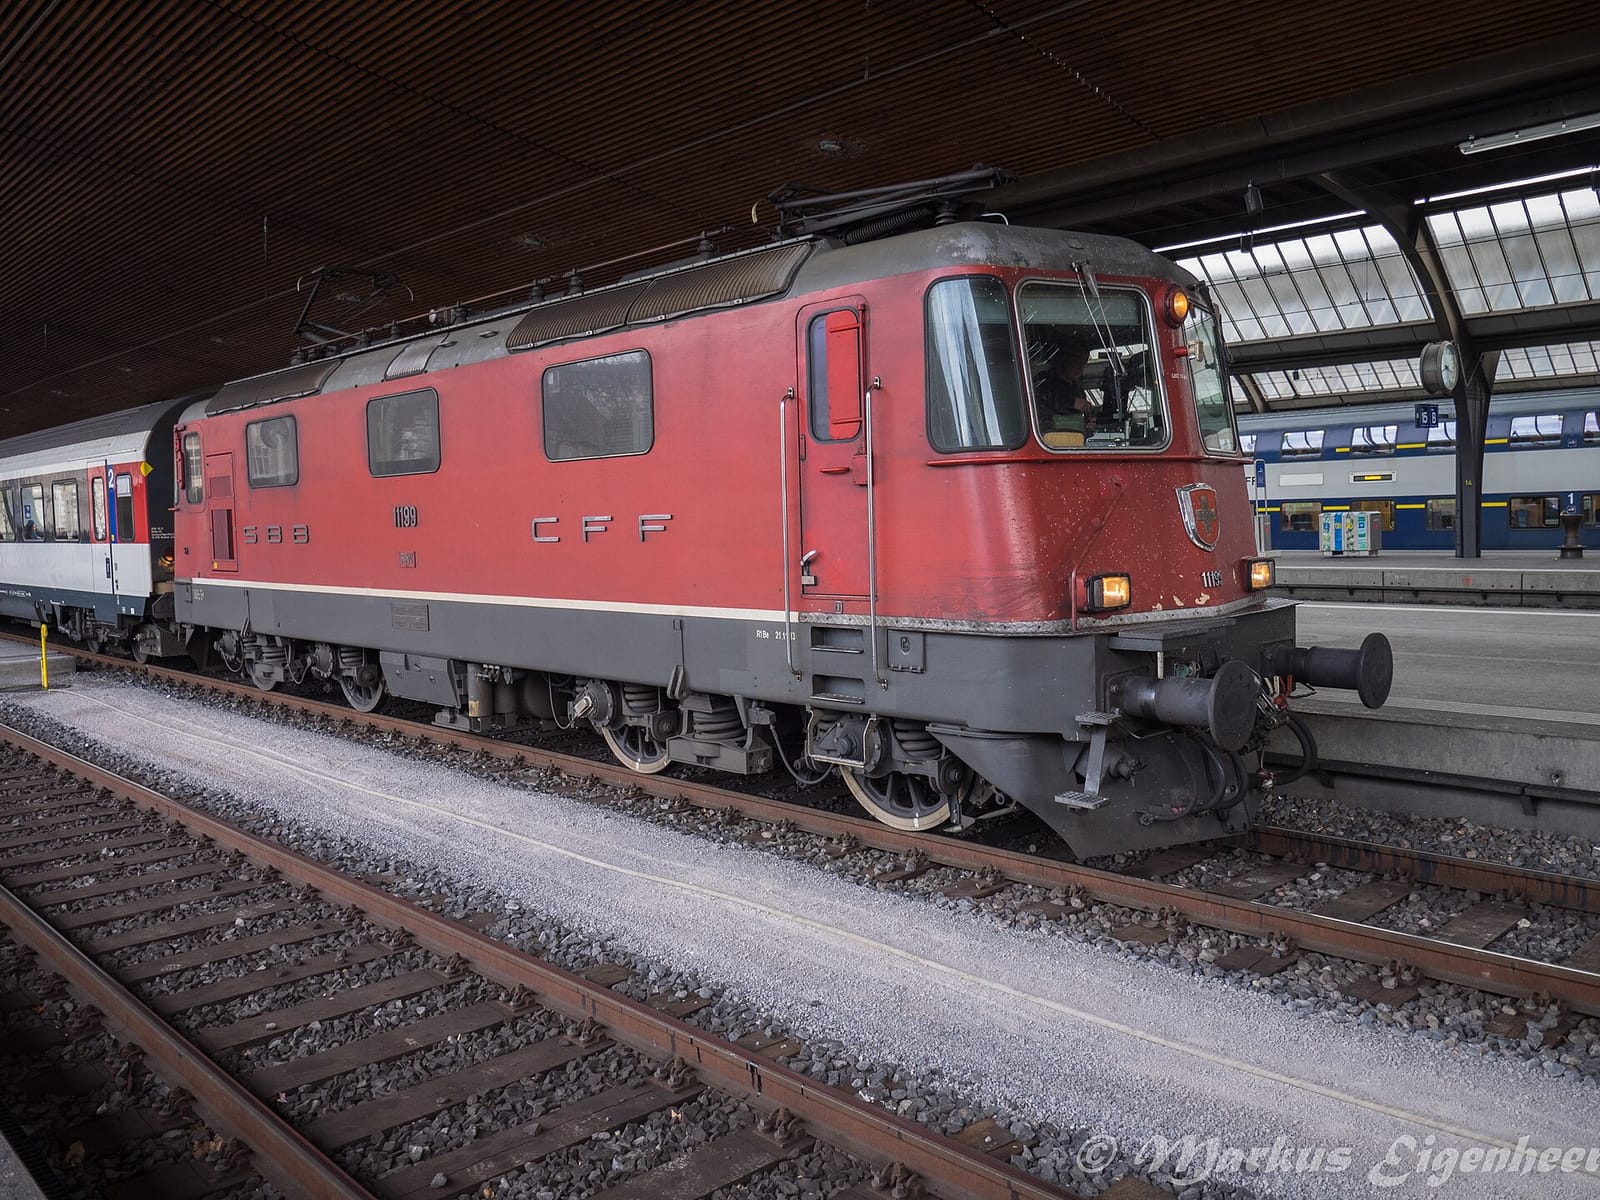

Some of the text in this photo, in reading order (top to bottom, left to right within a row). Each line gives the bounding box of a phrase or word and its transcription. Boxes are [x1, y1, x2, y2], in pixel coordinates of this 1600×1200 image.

[107, 468, 114, 489] 2
[1568, 492, 1574, 505] 1
[393, 505, 418, 528] 11199
[243, 525, 309, 544] SBB
[531, 513, 673, 543] CFF
